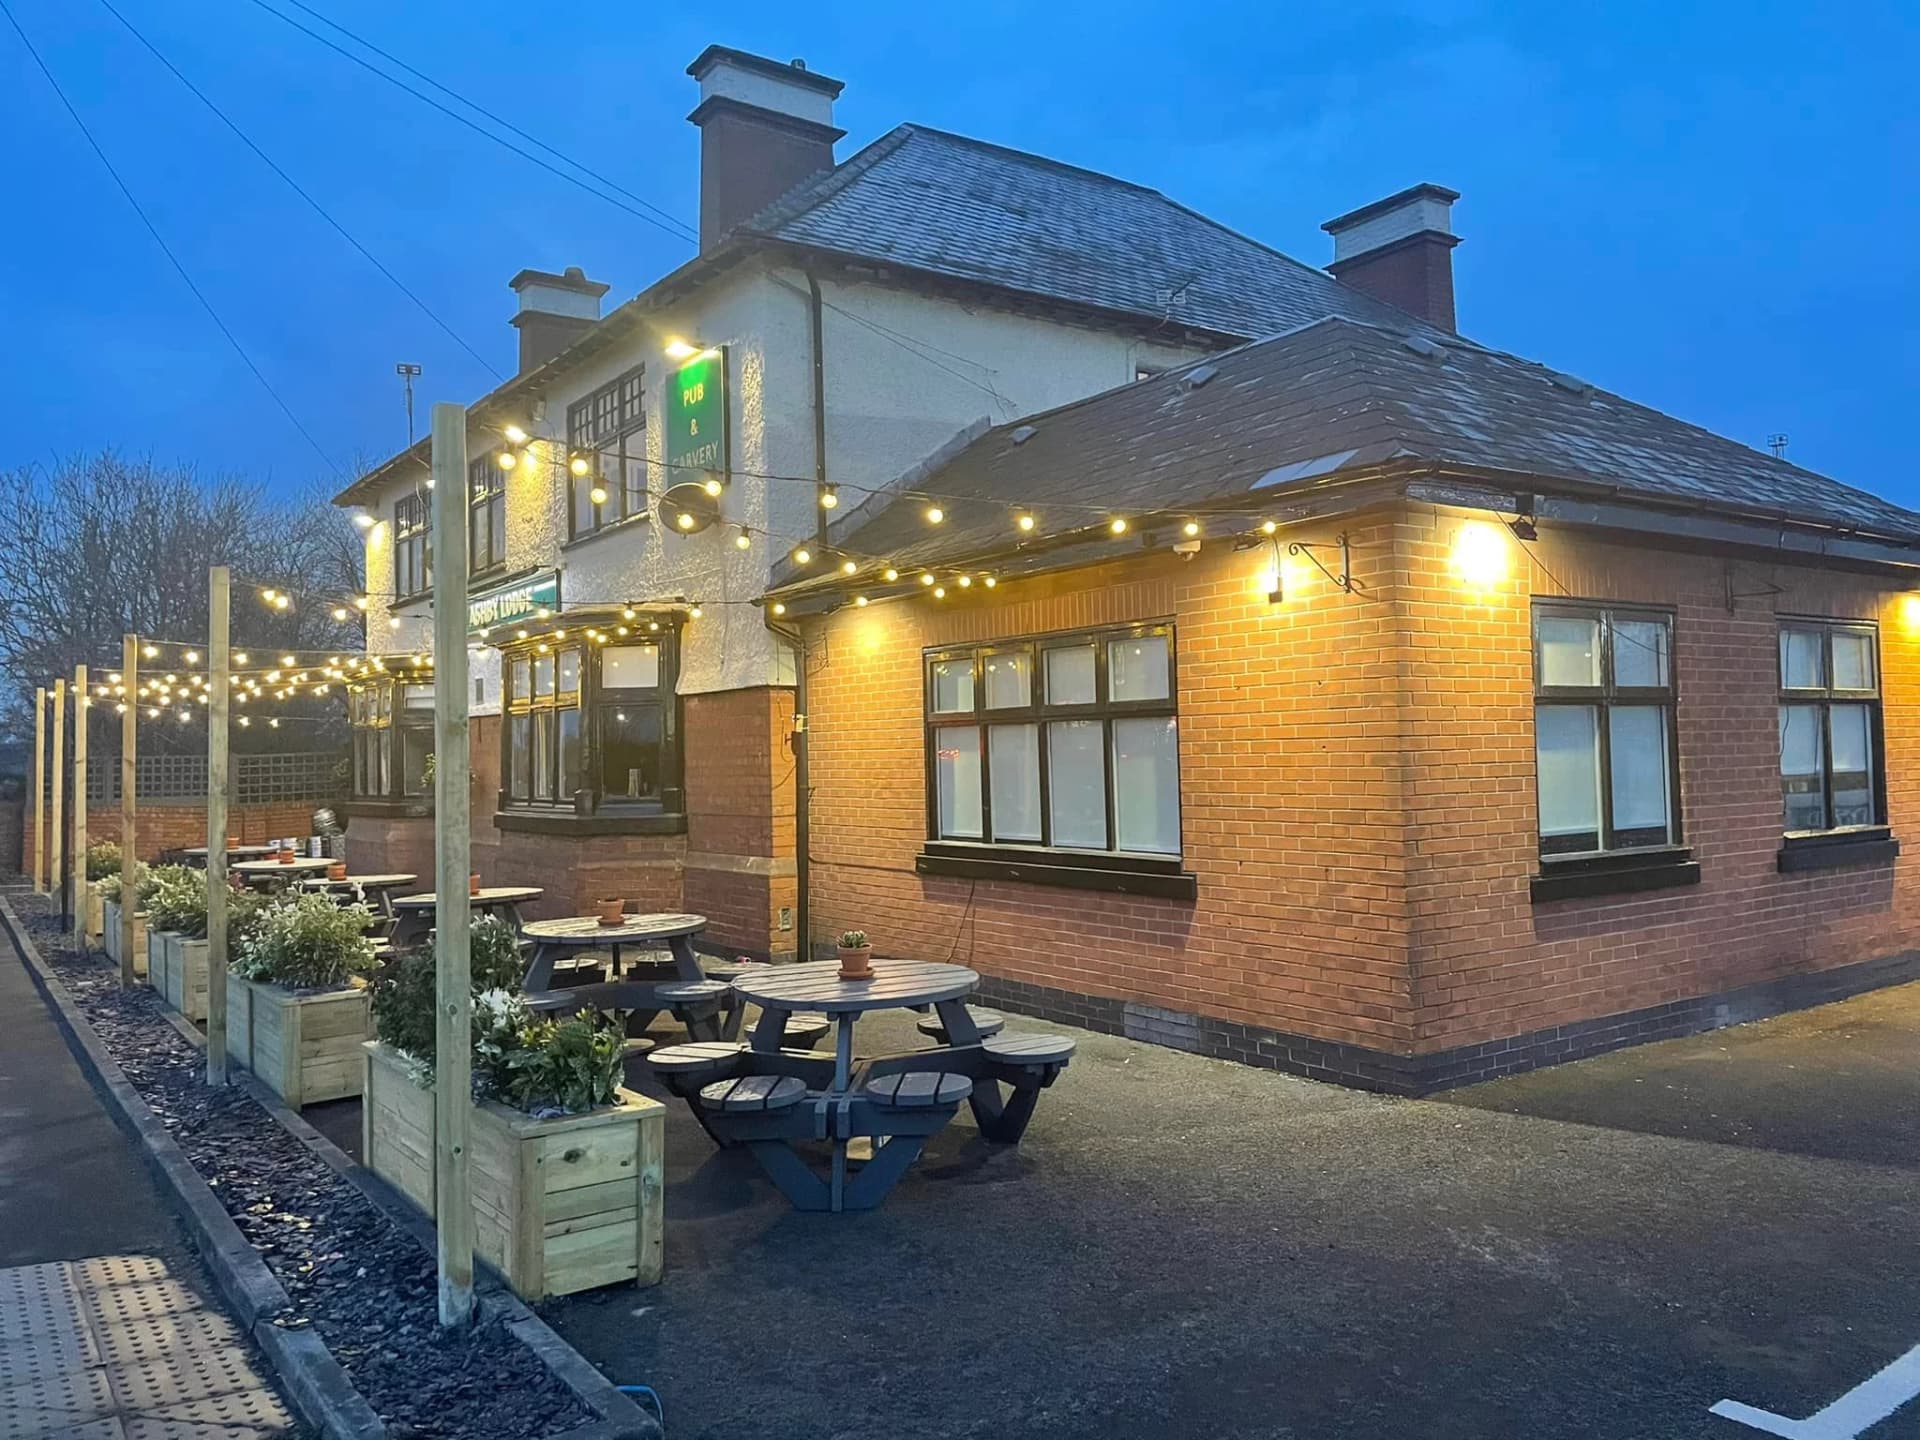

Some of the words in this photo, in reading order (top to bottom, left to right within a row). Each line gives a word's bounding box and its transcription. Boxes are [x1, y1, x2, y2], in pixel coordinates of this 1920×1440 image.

[683, 383, 704, 407] PUB
[690, 418, 699, 436] &
[672, 440, 719, 474] CARVERY
[469, 595, 499, 626] ASHBY
[500, 586, 533, 618] LODGE
